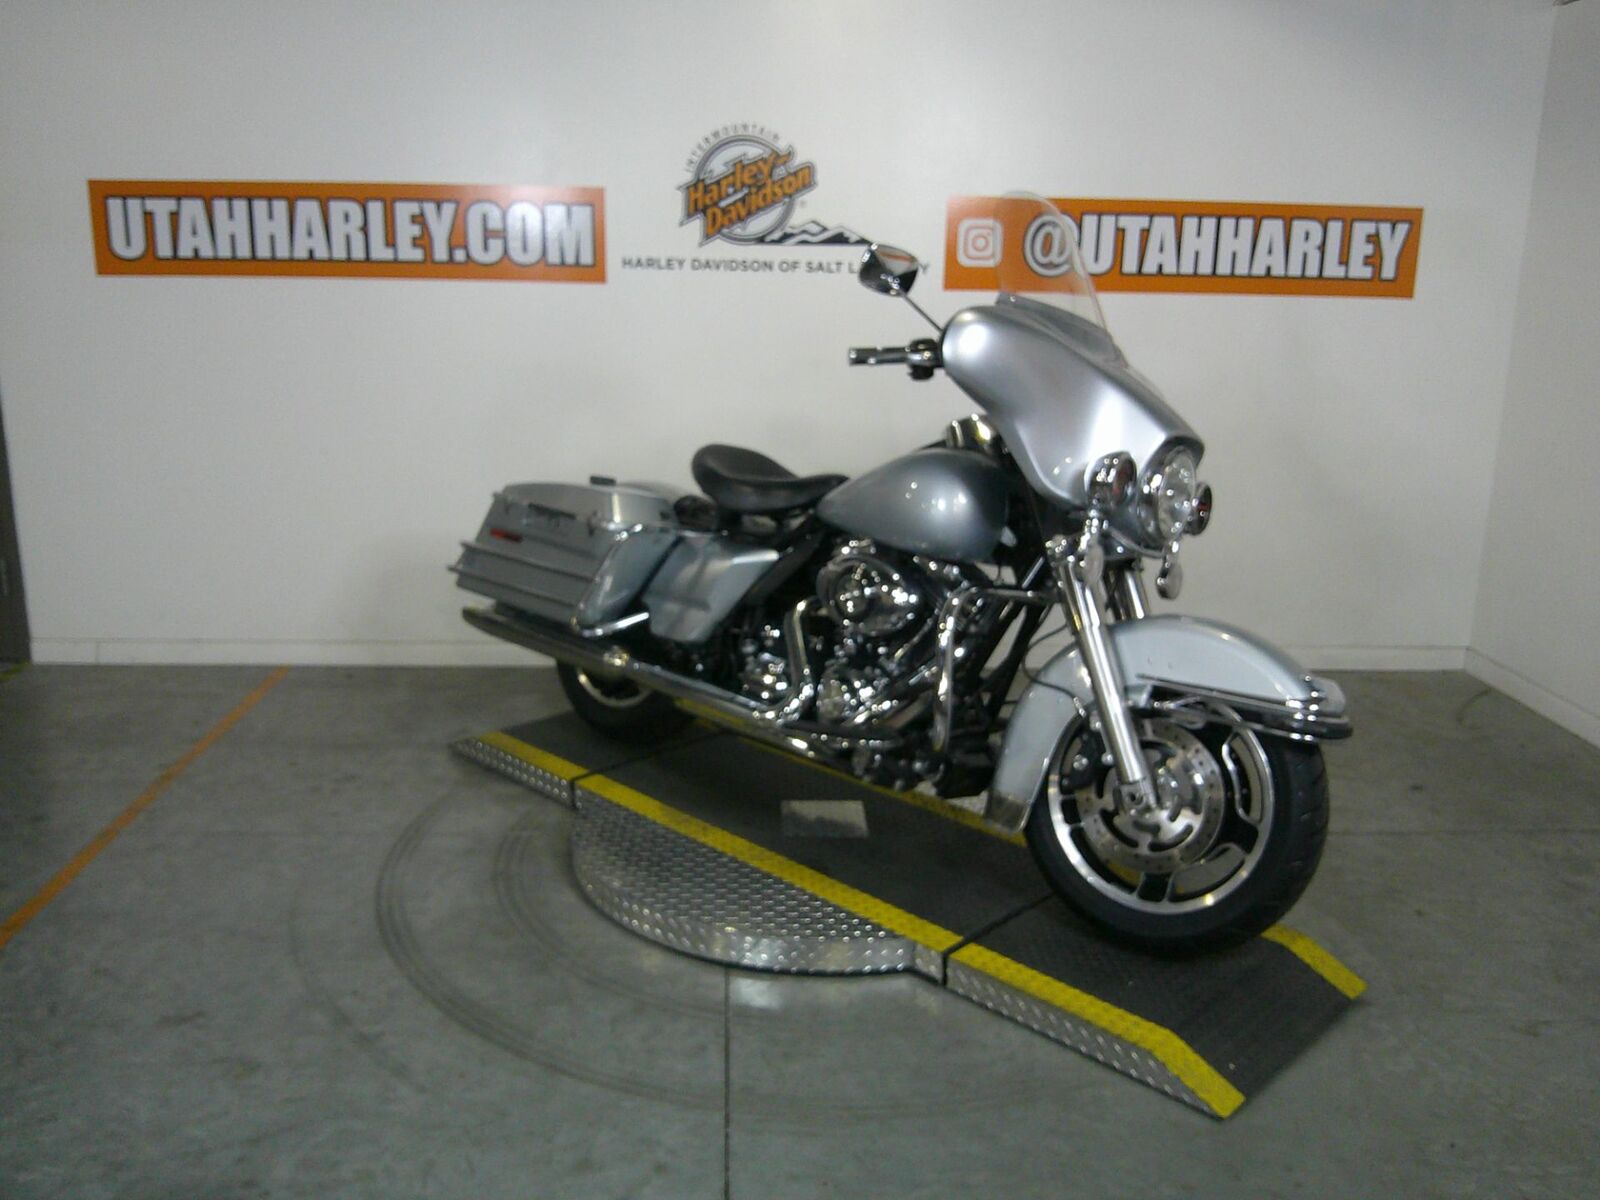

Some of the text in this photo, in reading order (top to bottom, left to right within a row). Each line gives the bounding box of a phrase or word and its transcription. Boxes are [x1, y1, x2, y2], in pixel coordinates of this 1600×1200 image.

[105, 194, 596, 266] UTAHHARLEY.COM
[705, 164, 813, 238] Davidson
[622, 257, 685, 270] HARLEY
[691, 258, 774, 271] DAVIDSON
[778, 260, 799, 272] OF
[805, 260, 842, 273] SALT
[1024, 211, 1411, 281] @UTAHHARLEY
